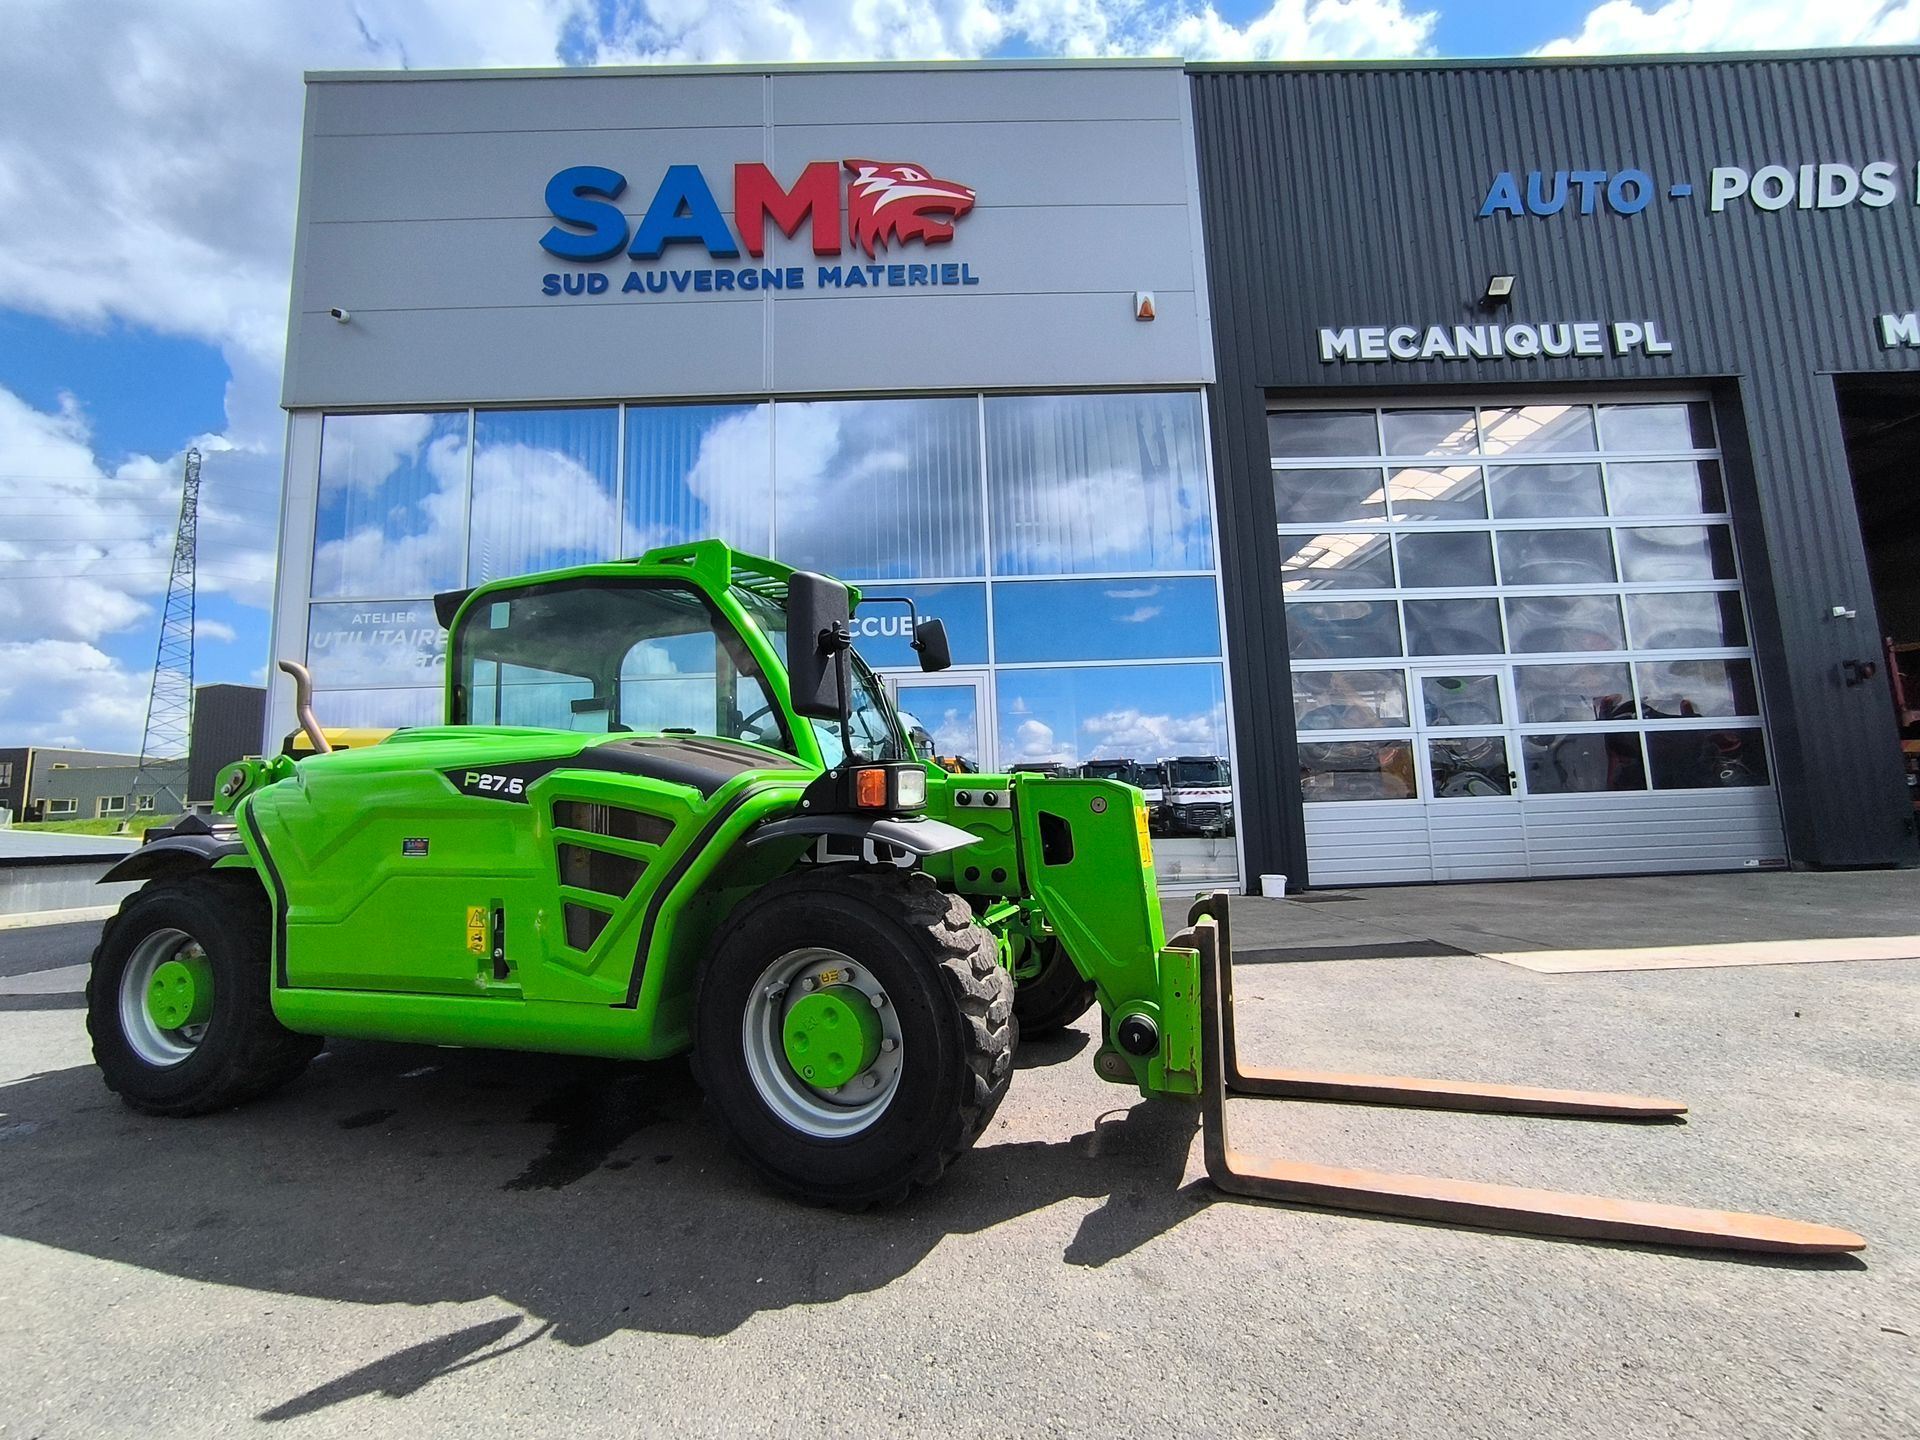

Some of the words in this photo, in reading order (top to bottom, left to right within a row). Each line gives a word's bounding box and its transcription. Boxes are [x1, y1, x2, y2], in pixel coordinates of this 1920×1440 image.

[1479, 169, 1653, 217] AUTO
[1711, 161, 1897, 212] POIDS
[539, 161, 841, 263] SAM
[542, 271, 609, 297] SUD
[622, 267, 805, 294] AUVERGNE
[817, 262, 979, 289] MATERIEL
[1318, 321, 1604, 363] MECANIQUE
[1612, 320, 1673, 355] PL
[352, 612, 416, 624] ATELIER
[464, 771, 524, 794] P27.6
